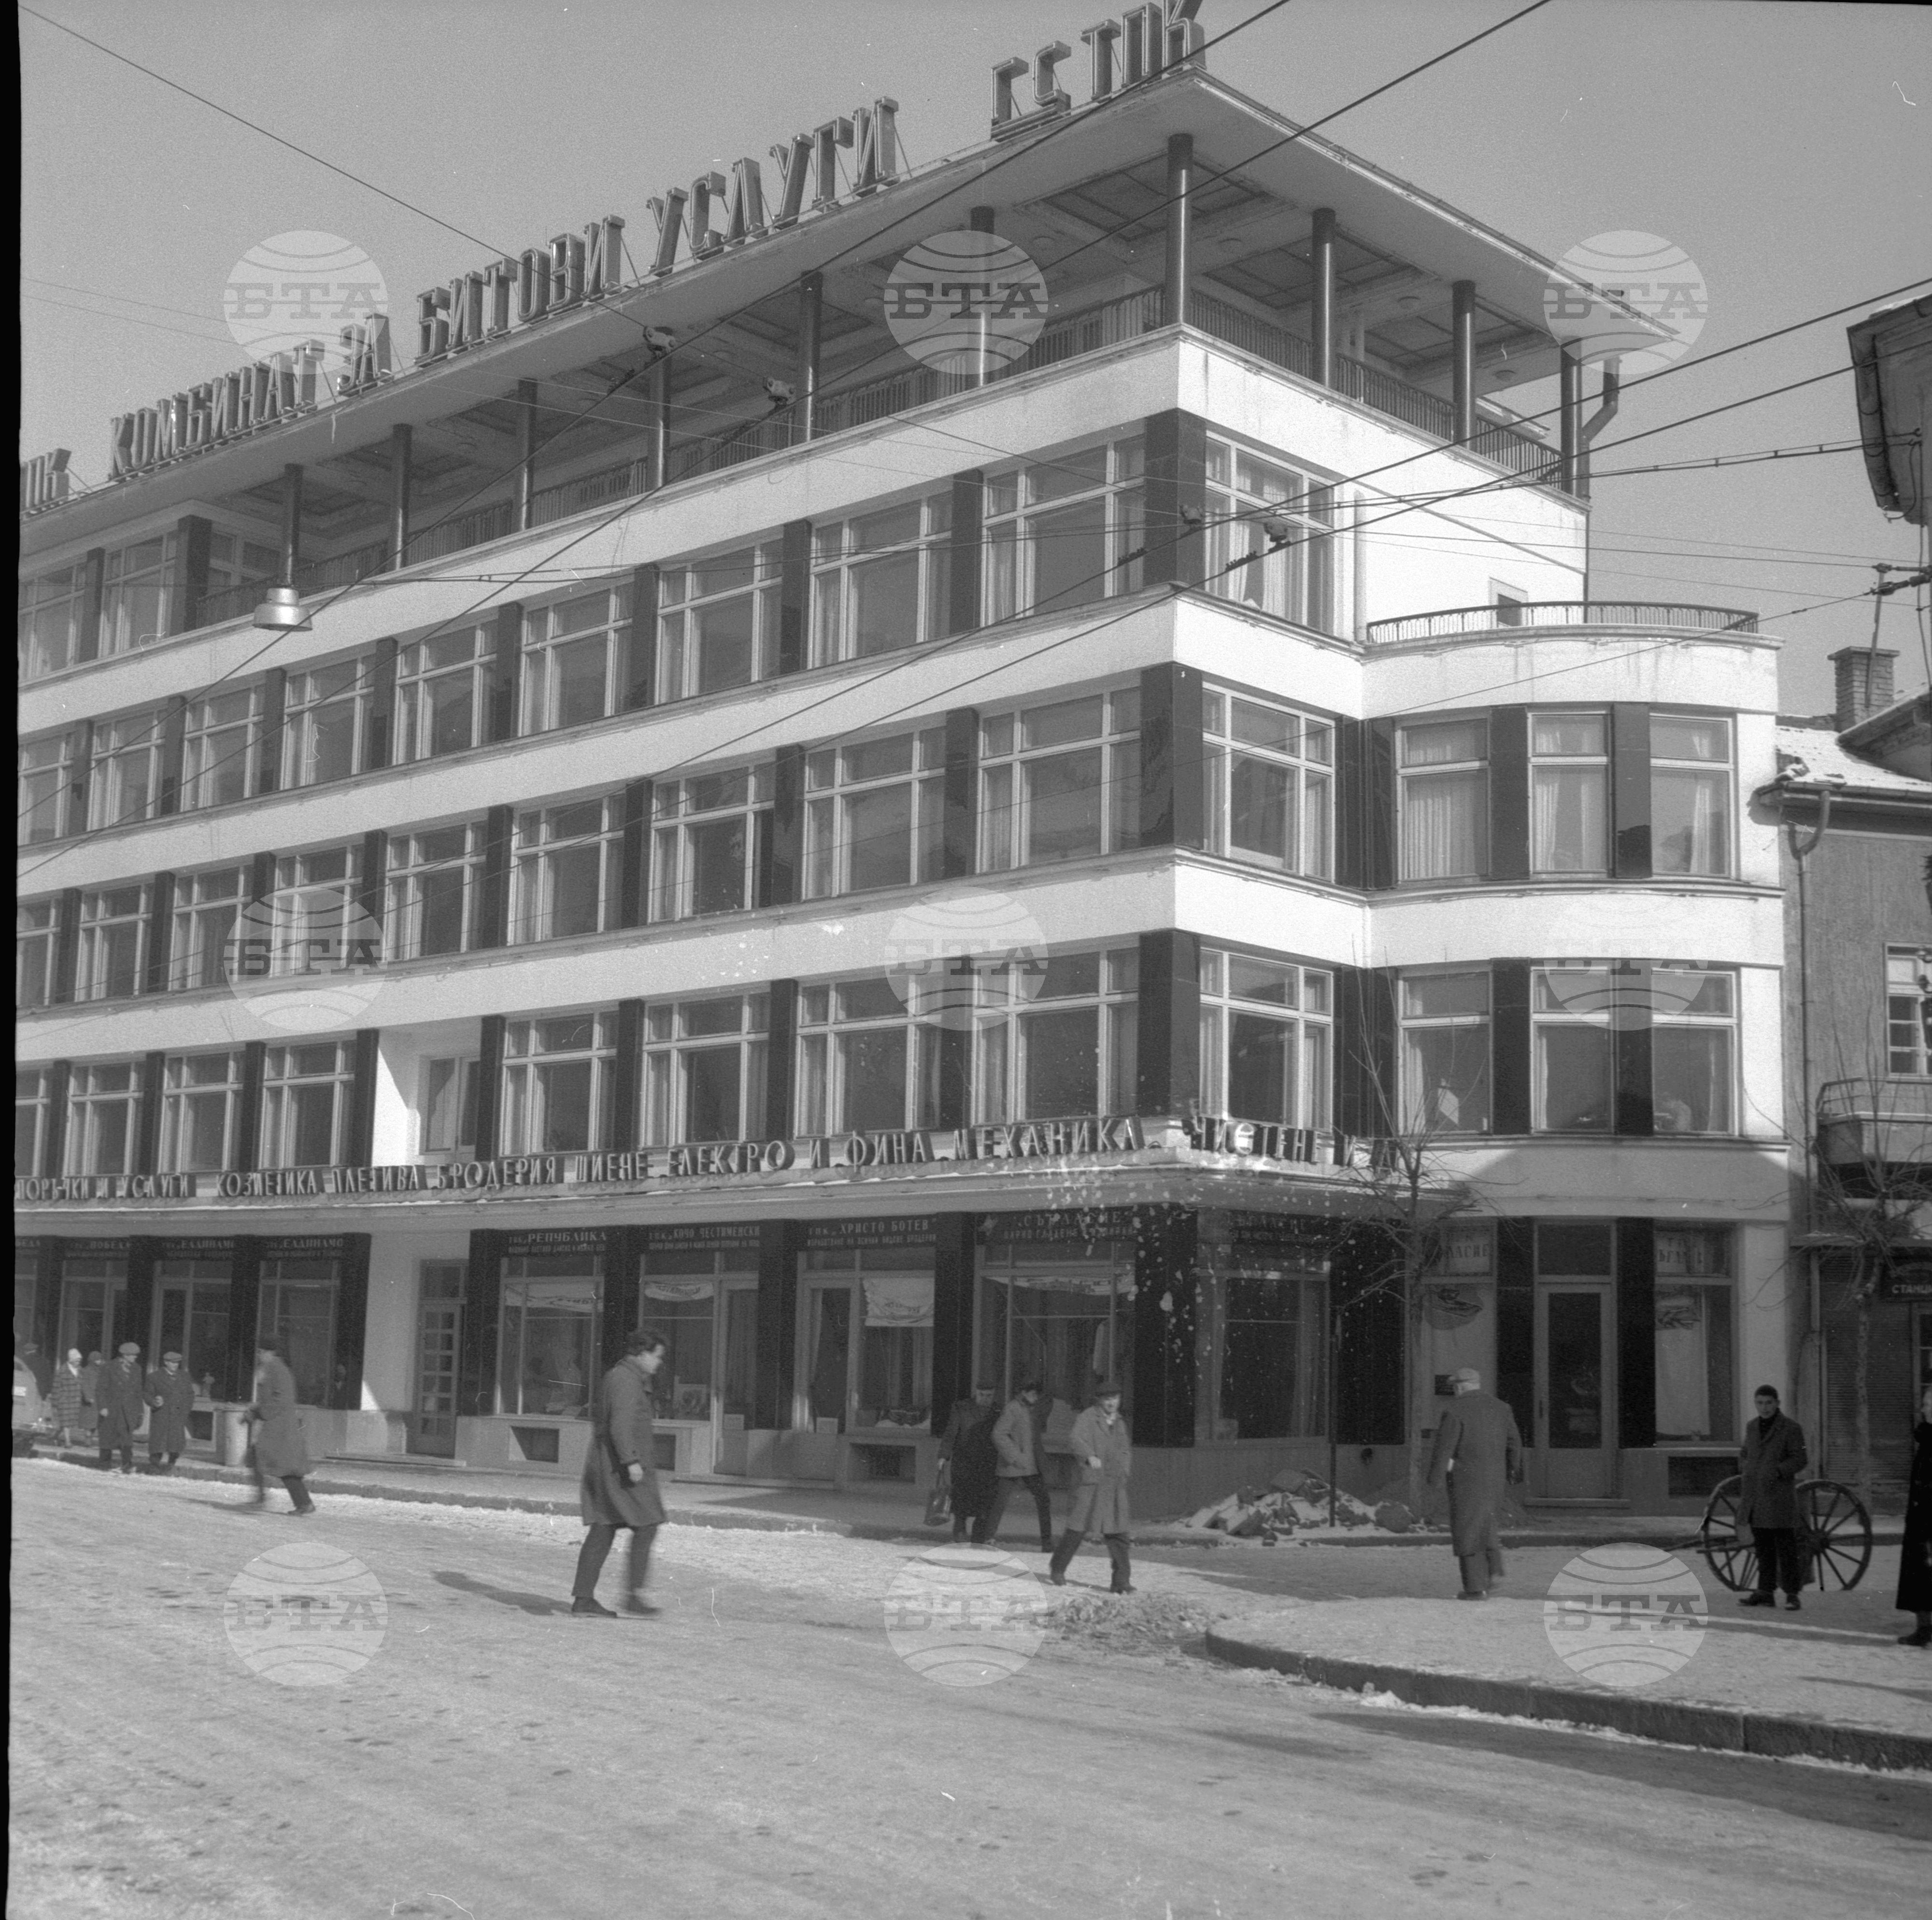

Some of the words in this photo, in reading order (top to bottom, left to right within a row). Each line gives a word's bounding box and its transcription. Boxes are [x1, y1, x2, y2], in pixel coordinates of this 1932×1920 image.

[109, 339, 325, 480] КОМБИНАТ
[338, 313, 392, 395] ЗА
[414, 214, 625, 366] БИТОВИ
[646, 97, 899, 275] УСЛУГИ
[122, 1175, 188, 1198] УСЛУГИ
[216, 1170, 317, 1197] КОЗМЕТИКА
[331, 1164, 419, 1193] ПЛЕТИВА
[437, 1156, 556, 1190] БРОДЕРИЯ
[575, 1151, 650, 1182] ШИЕНЕ
[668, 1140, 788, 1175] ЕЛЕКТРО
[810, 1139, 822, 1168] И
[844, 1130, 927, 1172] ФИНА
[953, 1118, 1139, 1160] МЕХАНИКА
